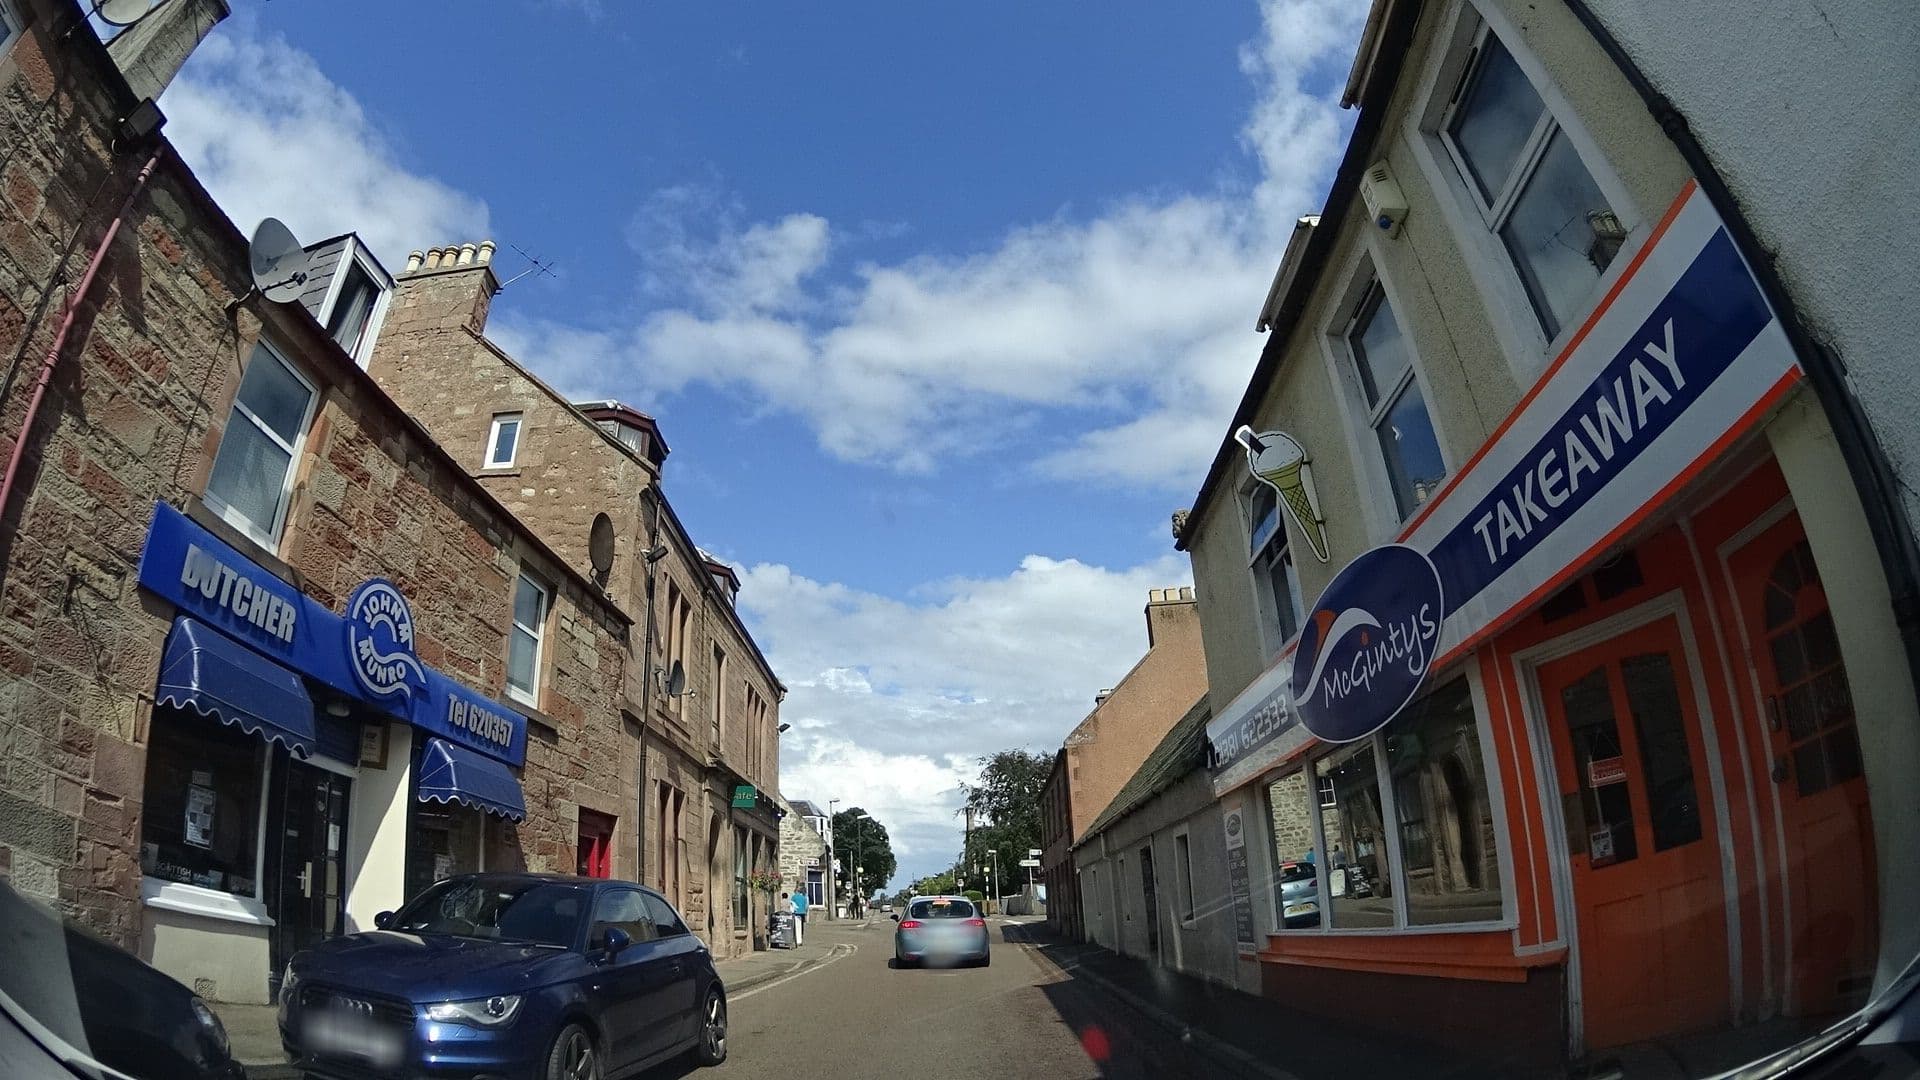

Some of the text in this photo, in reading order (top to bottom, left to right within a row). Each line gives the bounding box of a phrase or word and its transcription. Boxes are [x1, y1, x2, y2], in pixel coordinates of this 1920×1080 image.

[1473, 317, 1686, 565] TAKEAWAY
[181, 543, 297, 643] BUTCHER
[363, 593, 402, 623] JOHN
[358, 639, 406, 684] MUNRO
[1323, 602, 1436, 708] McGintys
[448, 693, 513, 747] Tel 620357
[1241, 694, 1289, 749] 622333
